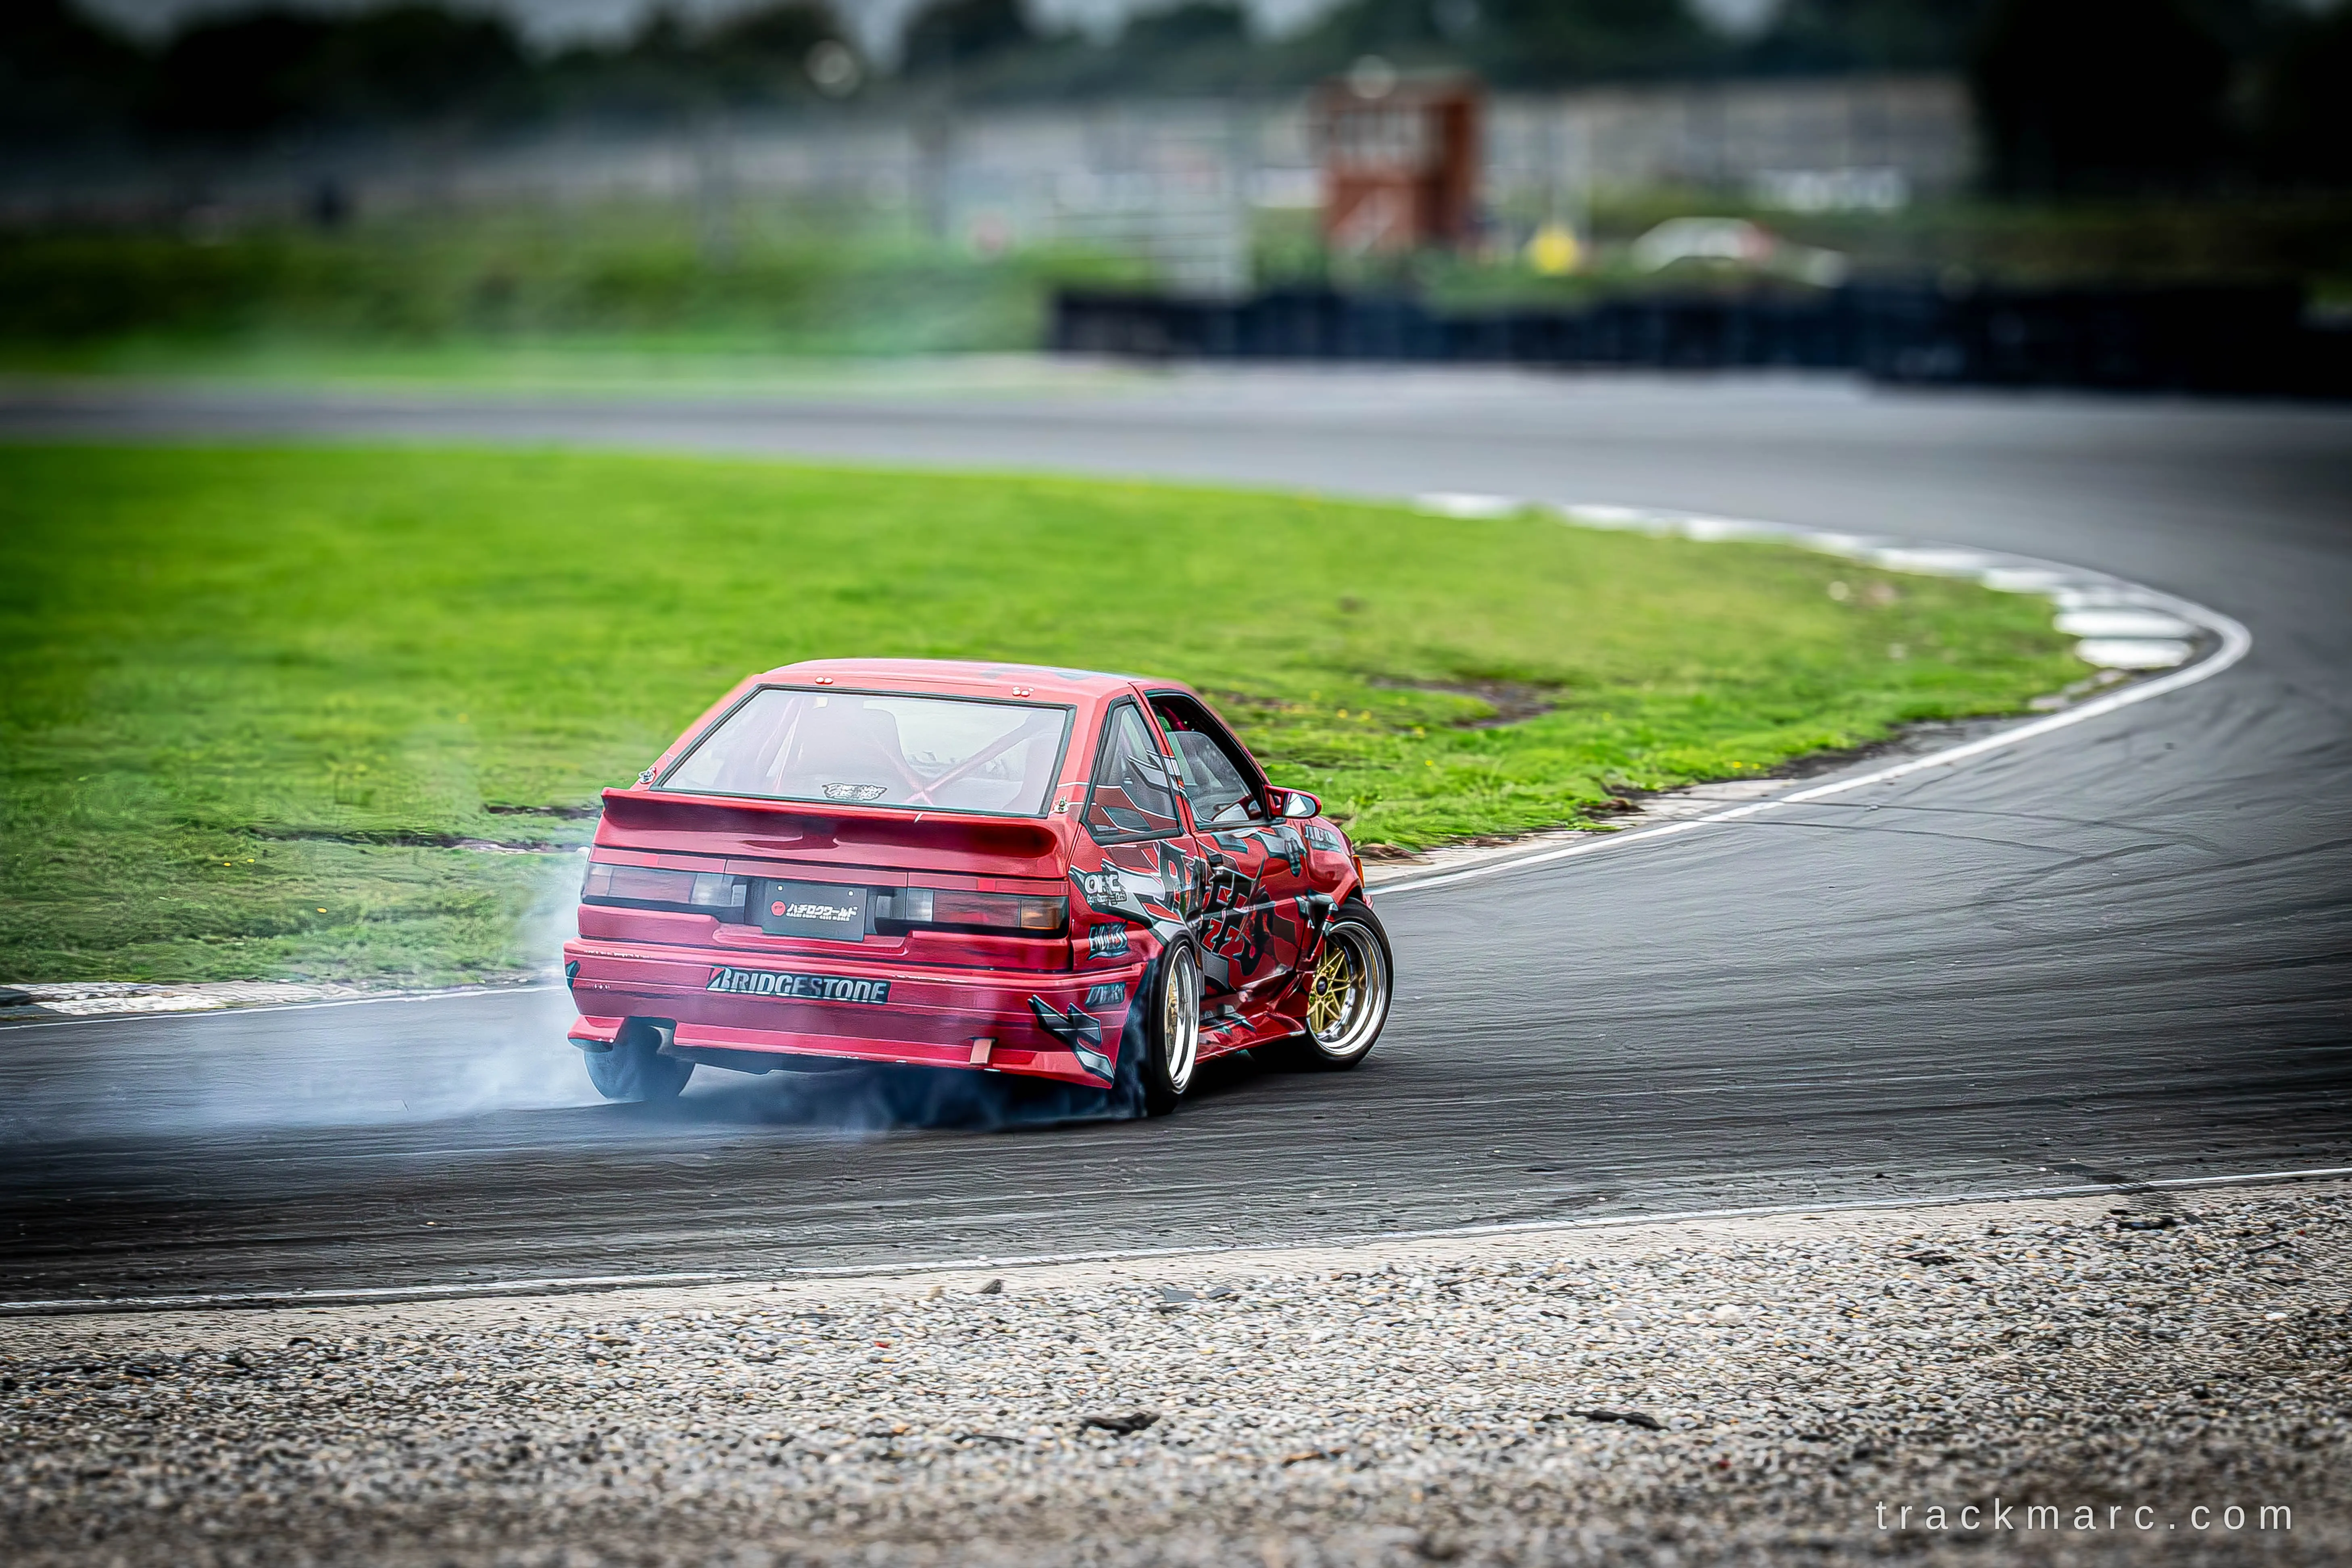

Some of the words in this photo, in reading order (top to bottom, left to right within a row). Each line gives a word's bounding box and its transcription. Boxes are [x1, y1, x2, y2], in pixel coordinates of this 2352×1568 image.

[1084, 874, 1122, 895] ORC
[786, 903, 858, 917] ハチロクワールド
[709, 967, 887, 1003] BRIDGESTONE
